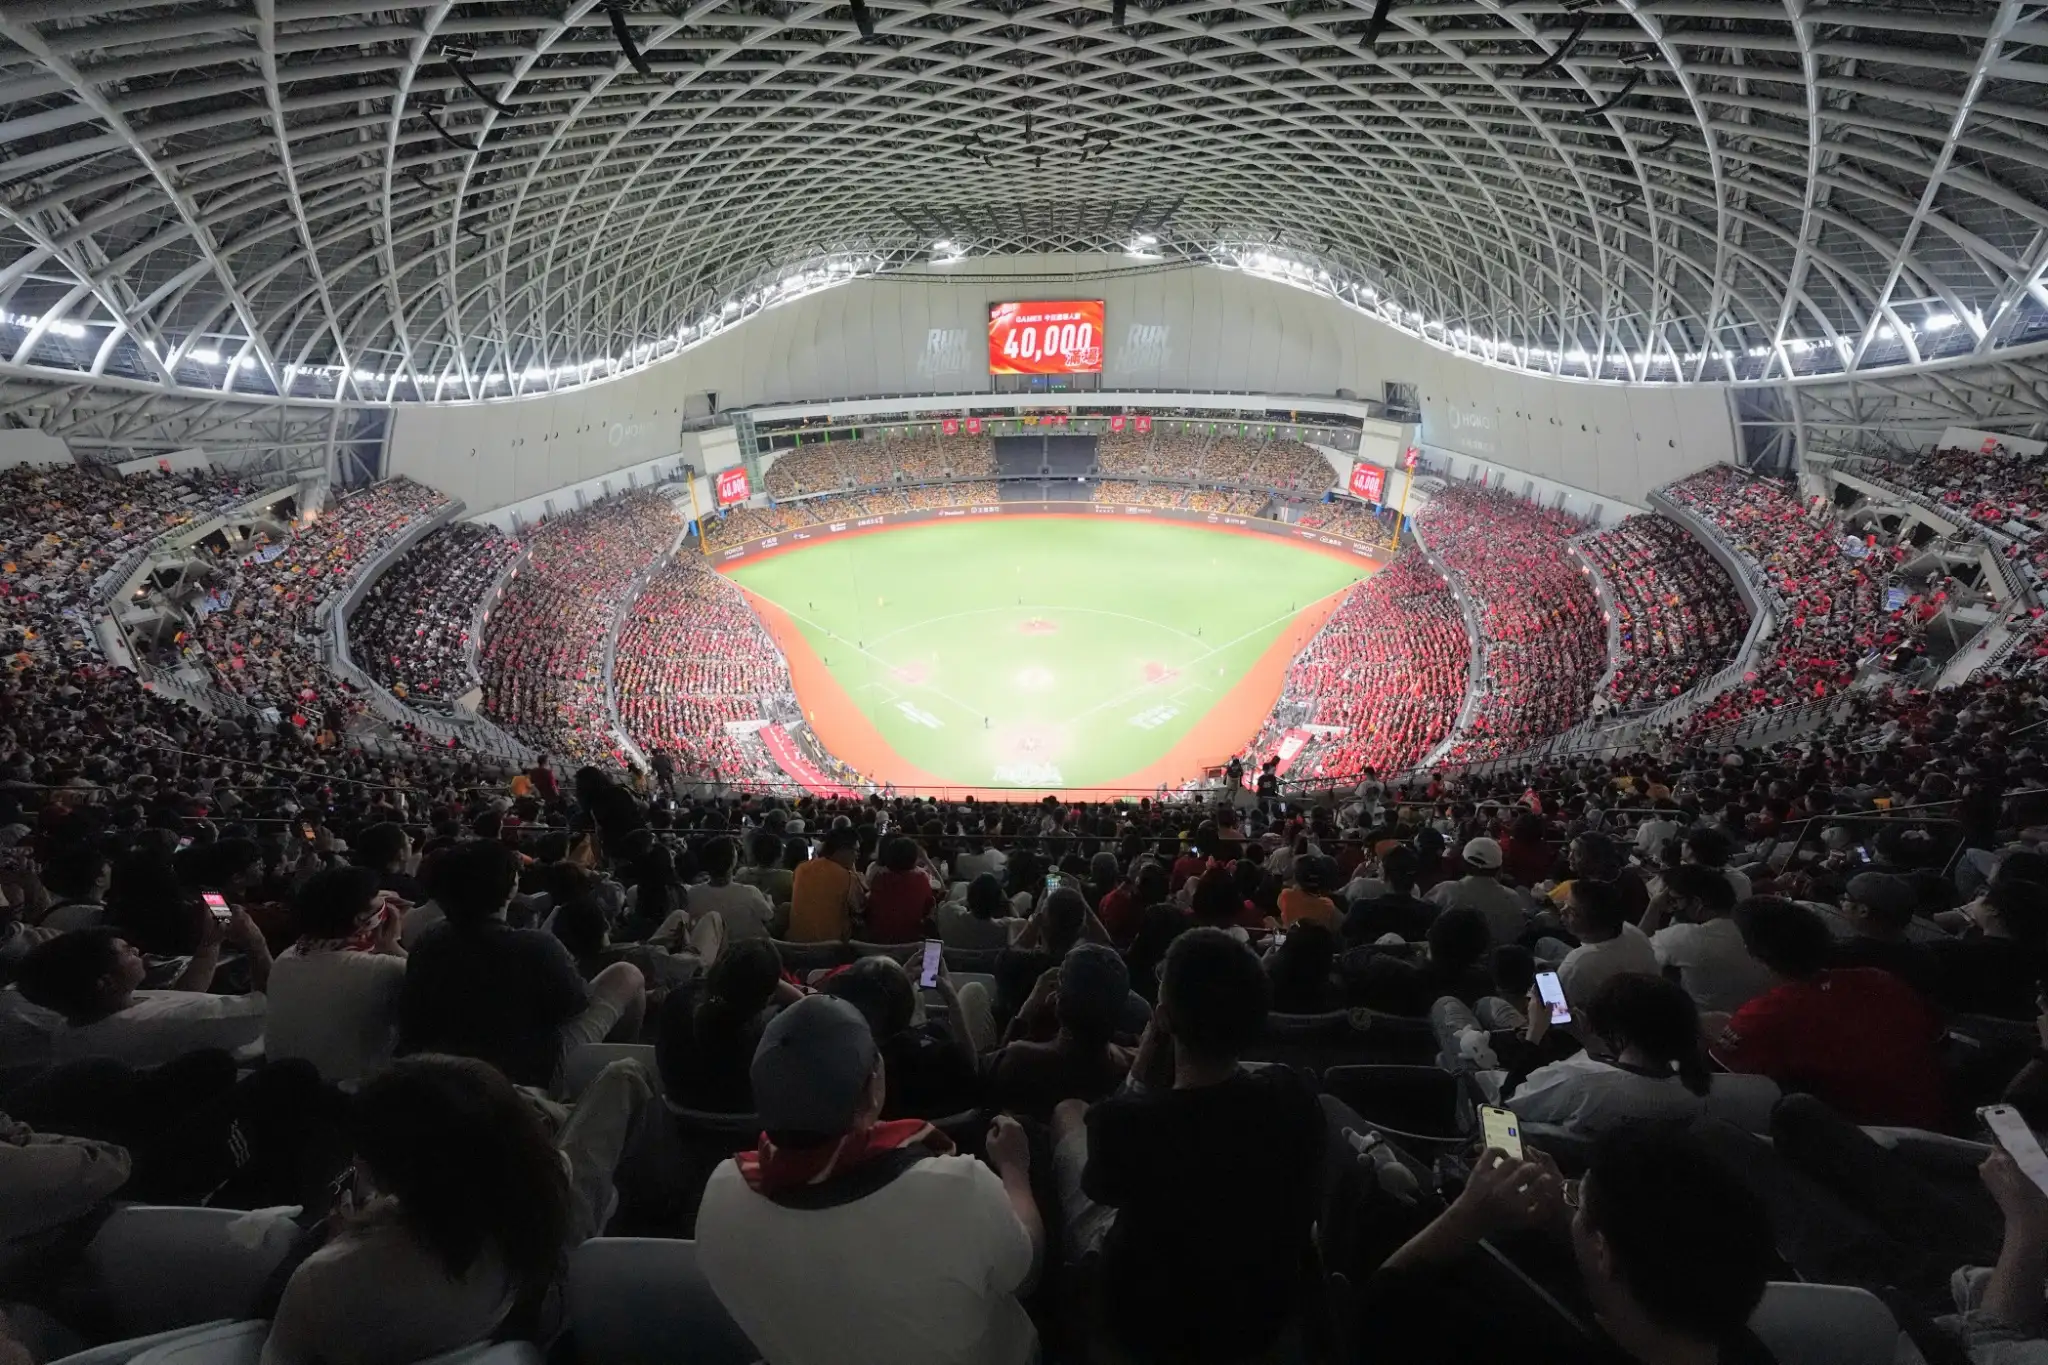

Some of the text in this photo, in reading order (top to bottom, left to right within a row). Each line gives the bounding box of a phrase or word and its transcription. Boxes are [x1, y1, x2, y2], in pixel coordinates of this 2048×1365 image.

[927, 328, 968, 352] RUN
[1004, 323, 1092, 362] 40,000
[1128, 323, 1170, 350] RUN
[722, 476, 745, 498] 40,000
[1354, 473, 1380, 492] 40,000
